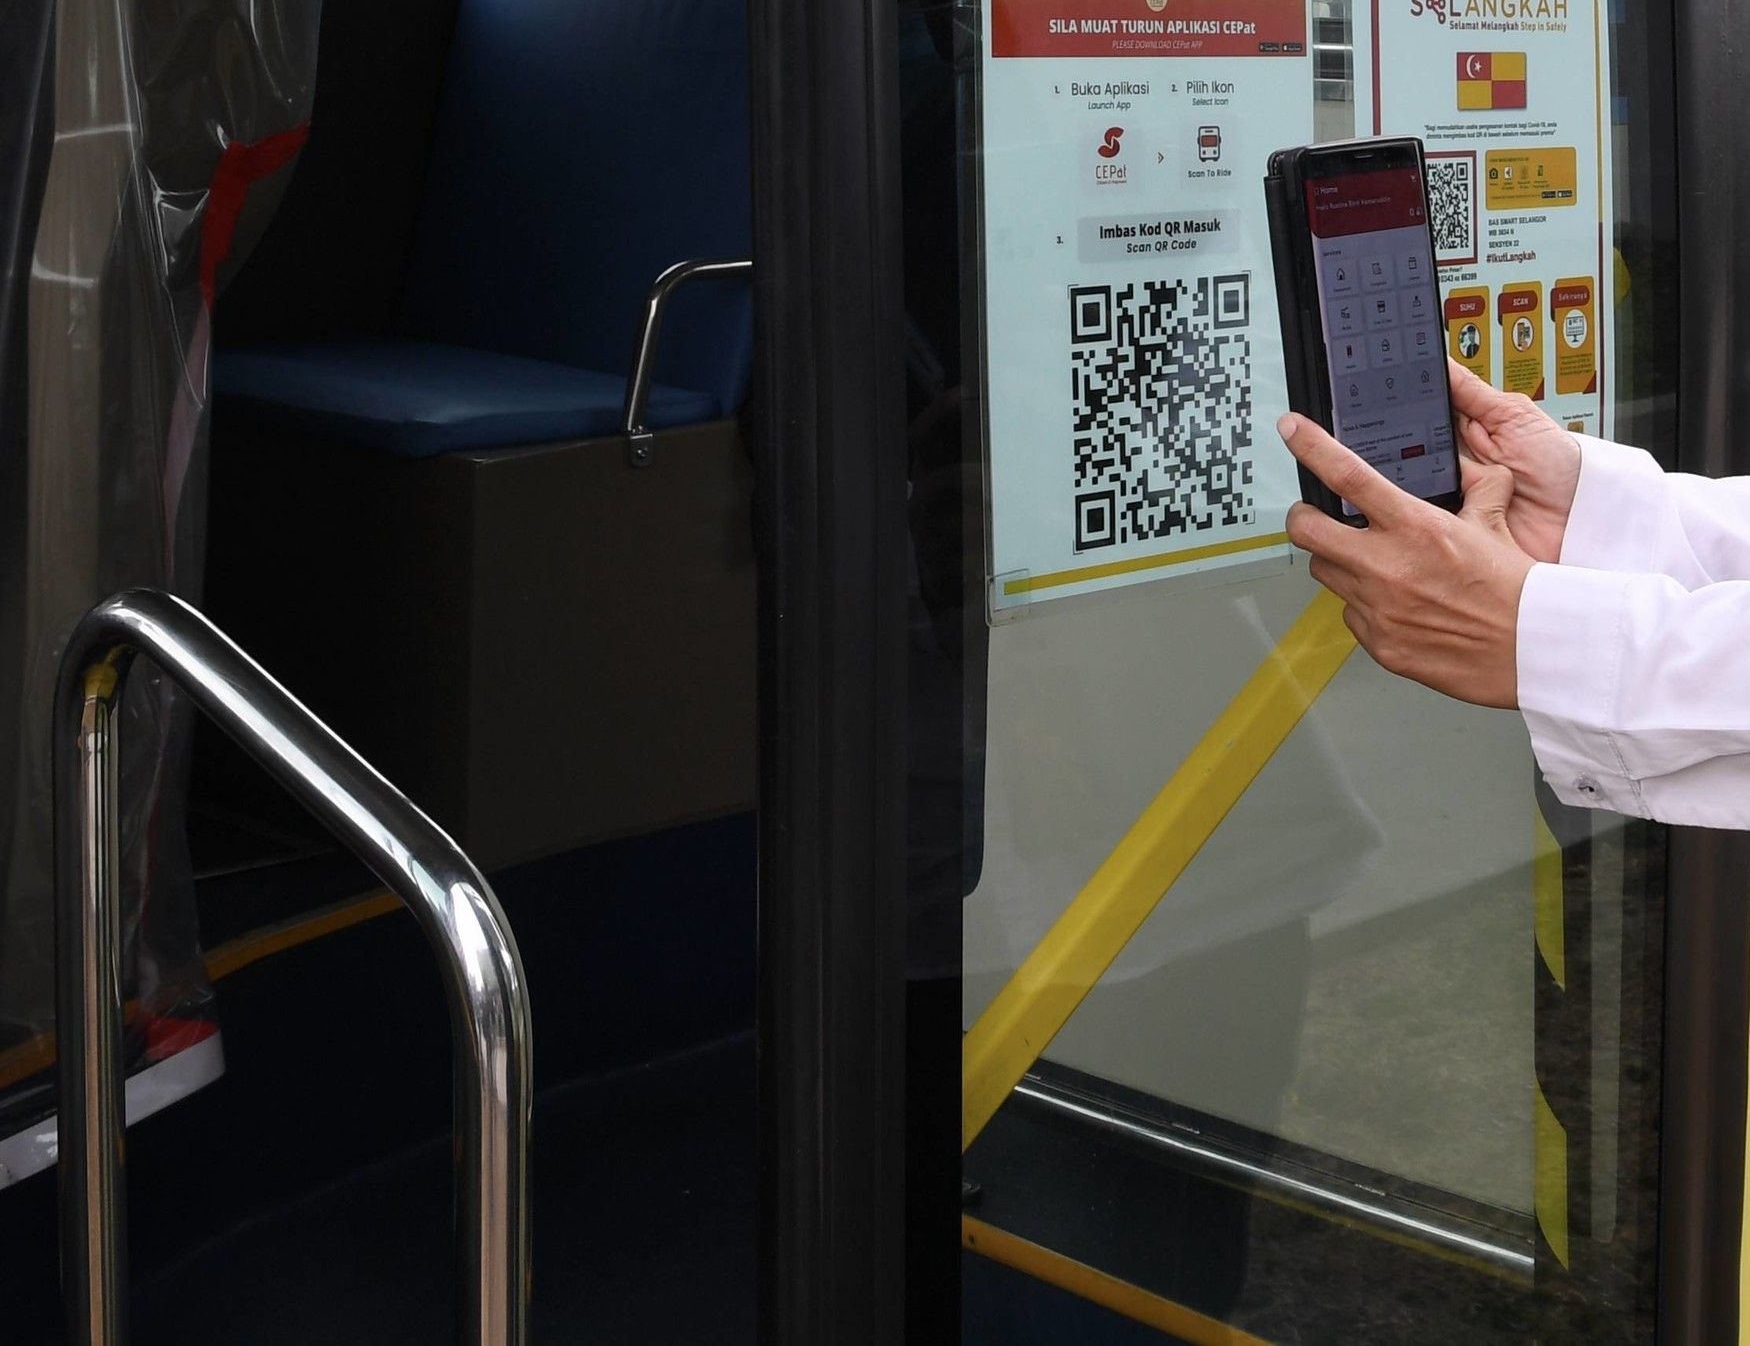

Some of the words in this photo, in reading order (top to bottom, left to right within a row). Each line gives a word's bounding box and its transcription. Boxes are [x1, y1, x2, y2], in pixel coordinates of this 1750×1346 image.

[1049, 19, 1077, 34] SILA
[1081, 19, 1118, 34] MUAT
[1121, 20, 1163, 34] TURUN
[1167, 20, 1220, 35] APLIKASI
[1223, 21, 1256, 35] CEPat
[1449, 20, 1479, 30] Selamat
[1481, 20, 1519, 32] Melangkah
[1520, 21, 1536, 32] Step
[1545, 21, 1567, 32] Safely
[1112, 40, 1134, 49] PLEASE
[1135, 40, 1171, 49] DOWNLOAD
[1071, 82, 1101, 95] Buka
[1104, 81, 1149, 97] Aplikasi
[1186, 81, 1209, 94] Pilih
[1212, 81, 1234, 94] Ikon
[1088, 101, 1113, 110] Launch
[1115, 101, 1131, 111] App
[1192, 97, 1212, 106] Select
[1214, 97, 1229, 105] Icon
[1096, 164, 1127, 179] CEPat
[1188, 170, 1205, 178] Scan
[1207, 169, 1215, 177] To
[1217, 168, 1231, 177] Ride
[1488, 218, 1499, 226] BAS
[1500, 217, 1518, 225] SMART
[1519, 215, 1546, 224] SELANGOR
[1100, 225, 1136, 239] Imbas
[1140, 223, 1161, 236] Kod
[1164, 221, 1181, 237] QR
[1184, 218, 1221, 234] Masuk
[1057, 235, 1063, 244] 3.
[1127, 242, 1150, 254] Scan
[1155, 241, 1168, 252] QR
[1171, 238, 1197, 250] Code
[1486, 250, 1536, 263] #IkutLangkah
[1513, 297, 1529, 306] SCAN
